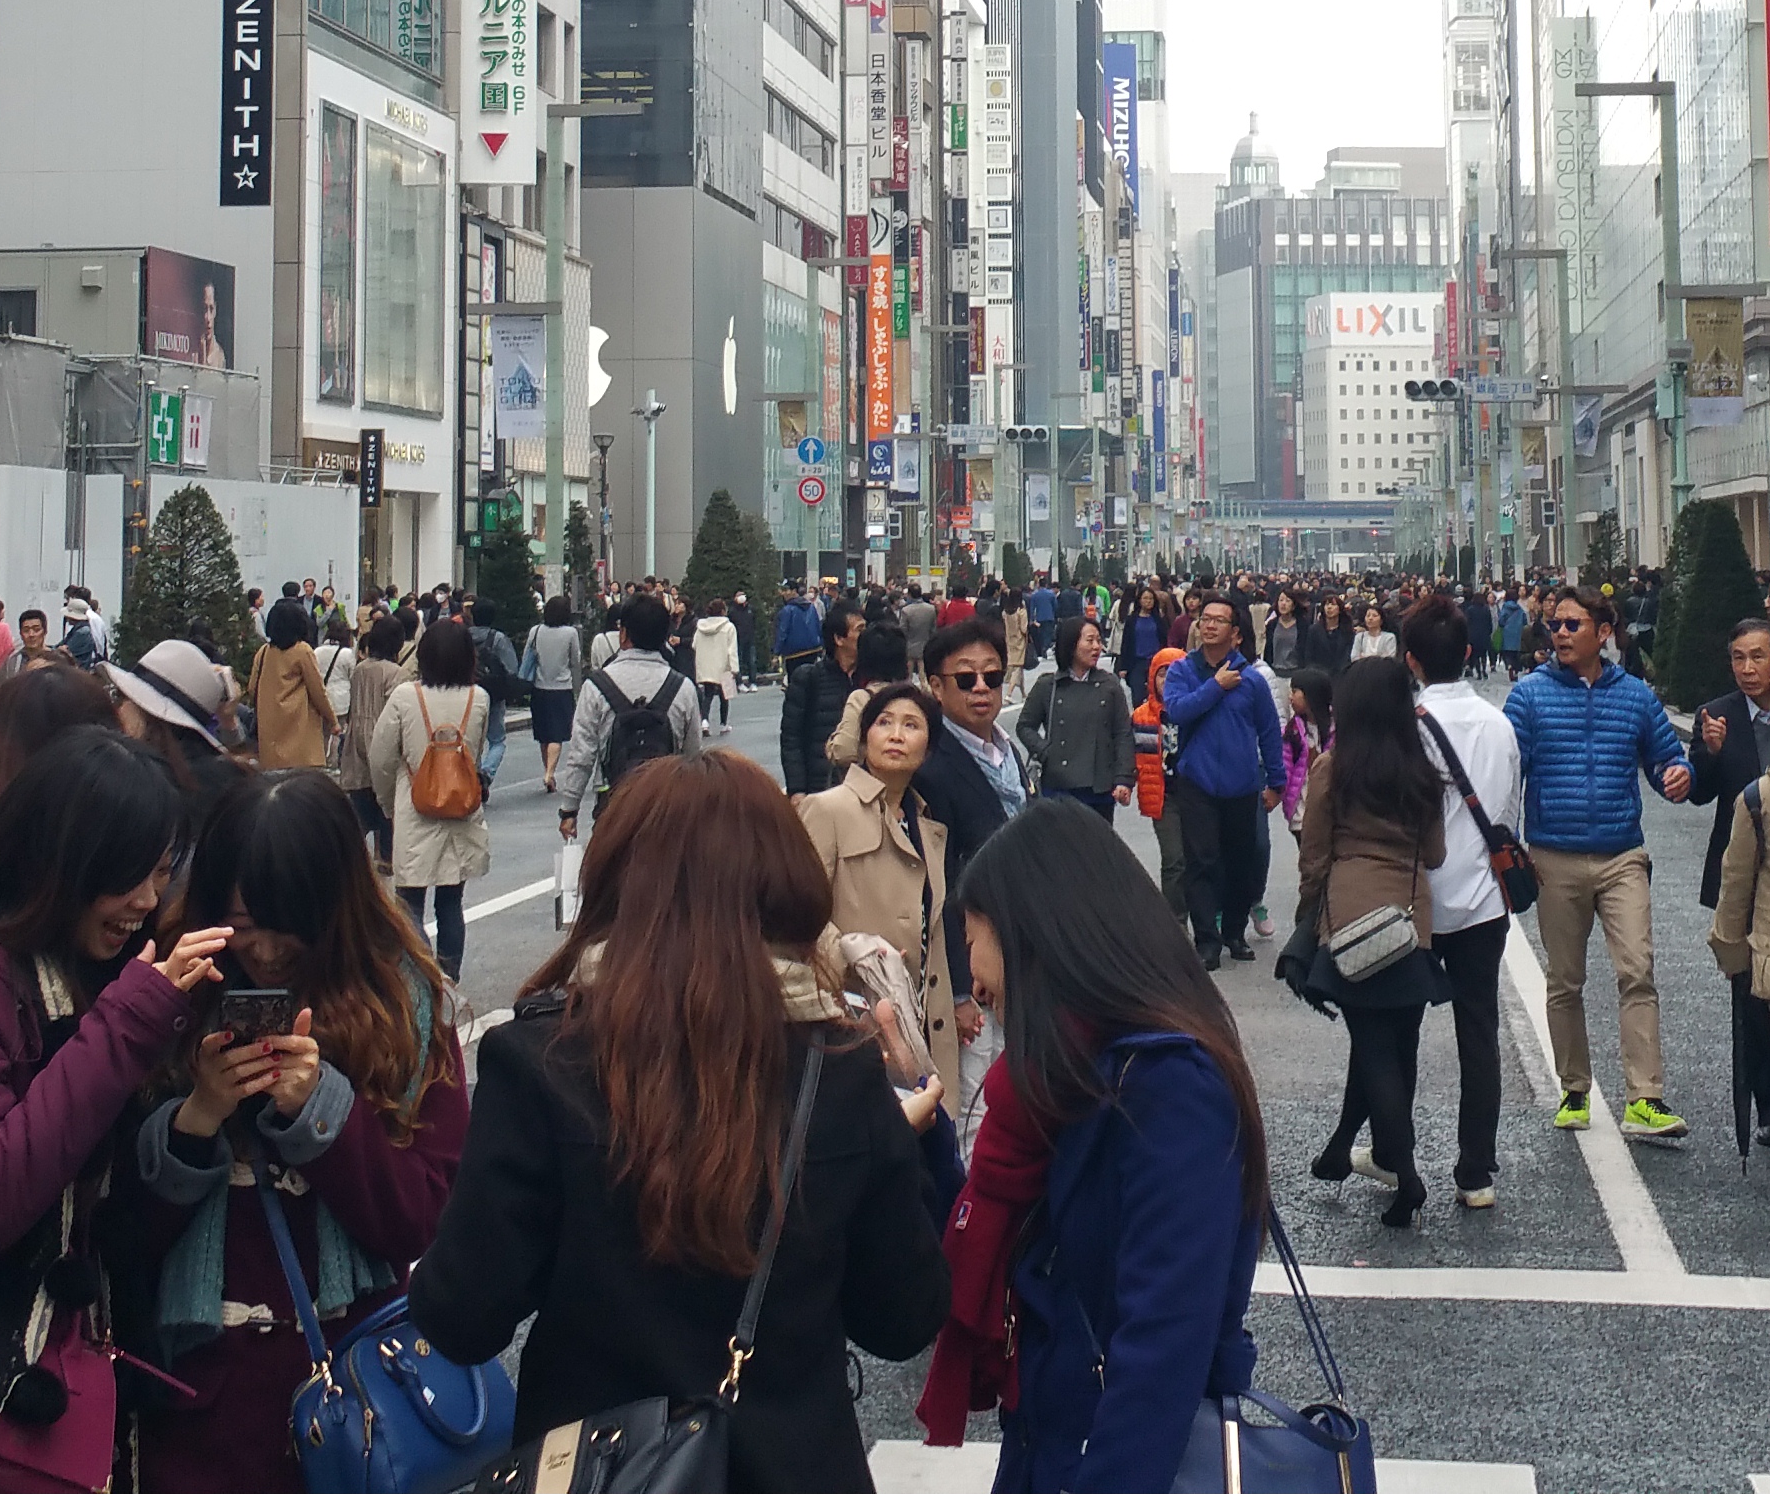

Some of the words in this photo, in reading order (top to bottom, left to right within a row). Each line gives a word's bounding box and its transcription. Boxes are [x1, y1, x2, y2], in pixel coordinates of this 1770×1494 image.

[512, 85, 526, 117] 6F
[869, 53, 889, 159] 日本香堂ビル
[1335, 303, 1428, 338] LIXIL
[154, 329, 191, 354] MIKIMOTO
[871, 265, 890, 428] すき焼・しゃぶしゃぶ・かに
[1169, 327, 1180, 364] ALBION
[323, 452, 356, 472] ZENITH
[366, 443, 377, 495] ZENITH
[803, 483, 820, 497] 50
